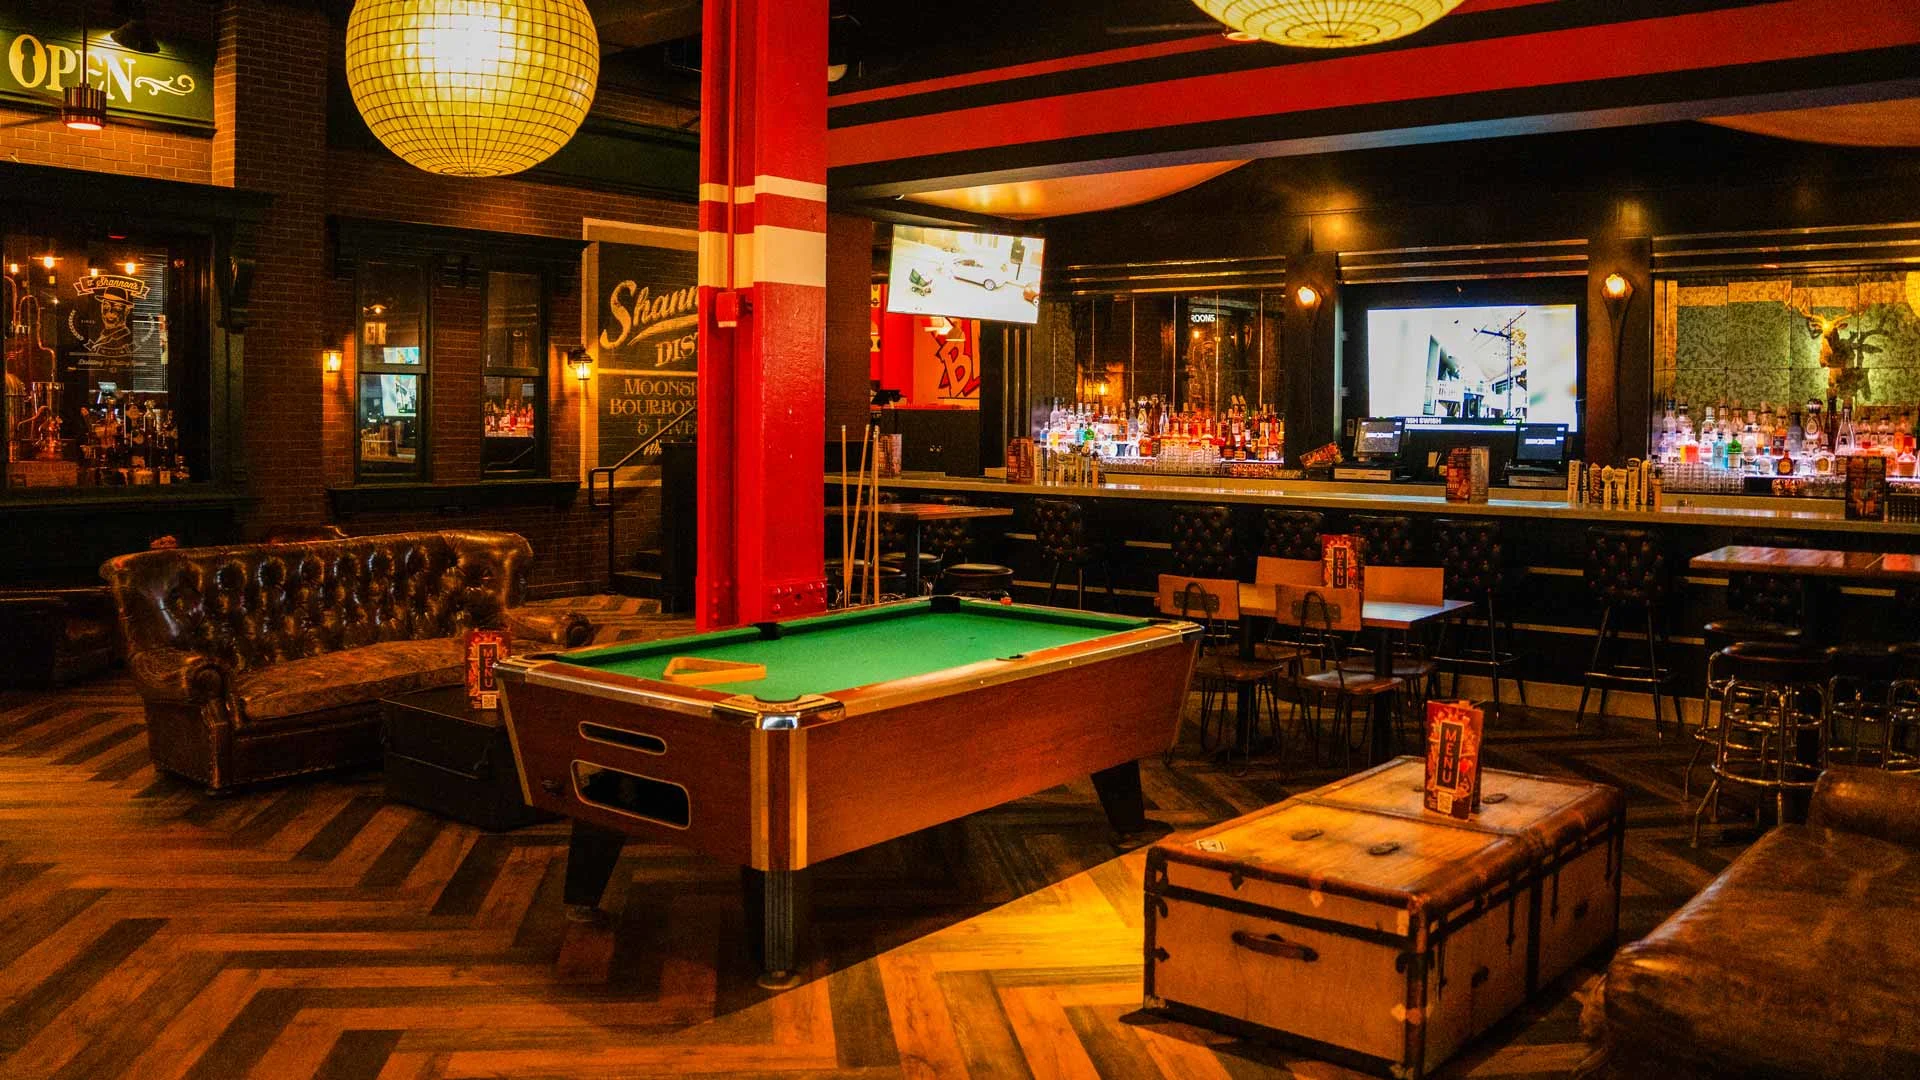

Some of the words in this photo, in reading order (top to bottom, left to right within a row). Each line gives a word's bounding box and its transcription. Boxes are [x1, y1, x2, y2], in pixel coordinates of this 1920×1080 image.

[654, 332, 698, 367] DIS
[1336, 550, 1344, 586] MENU
[482, 648, 494, 688] MENU
[1442, 728, 1458, 783] MENU
